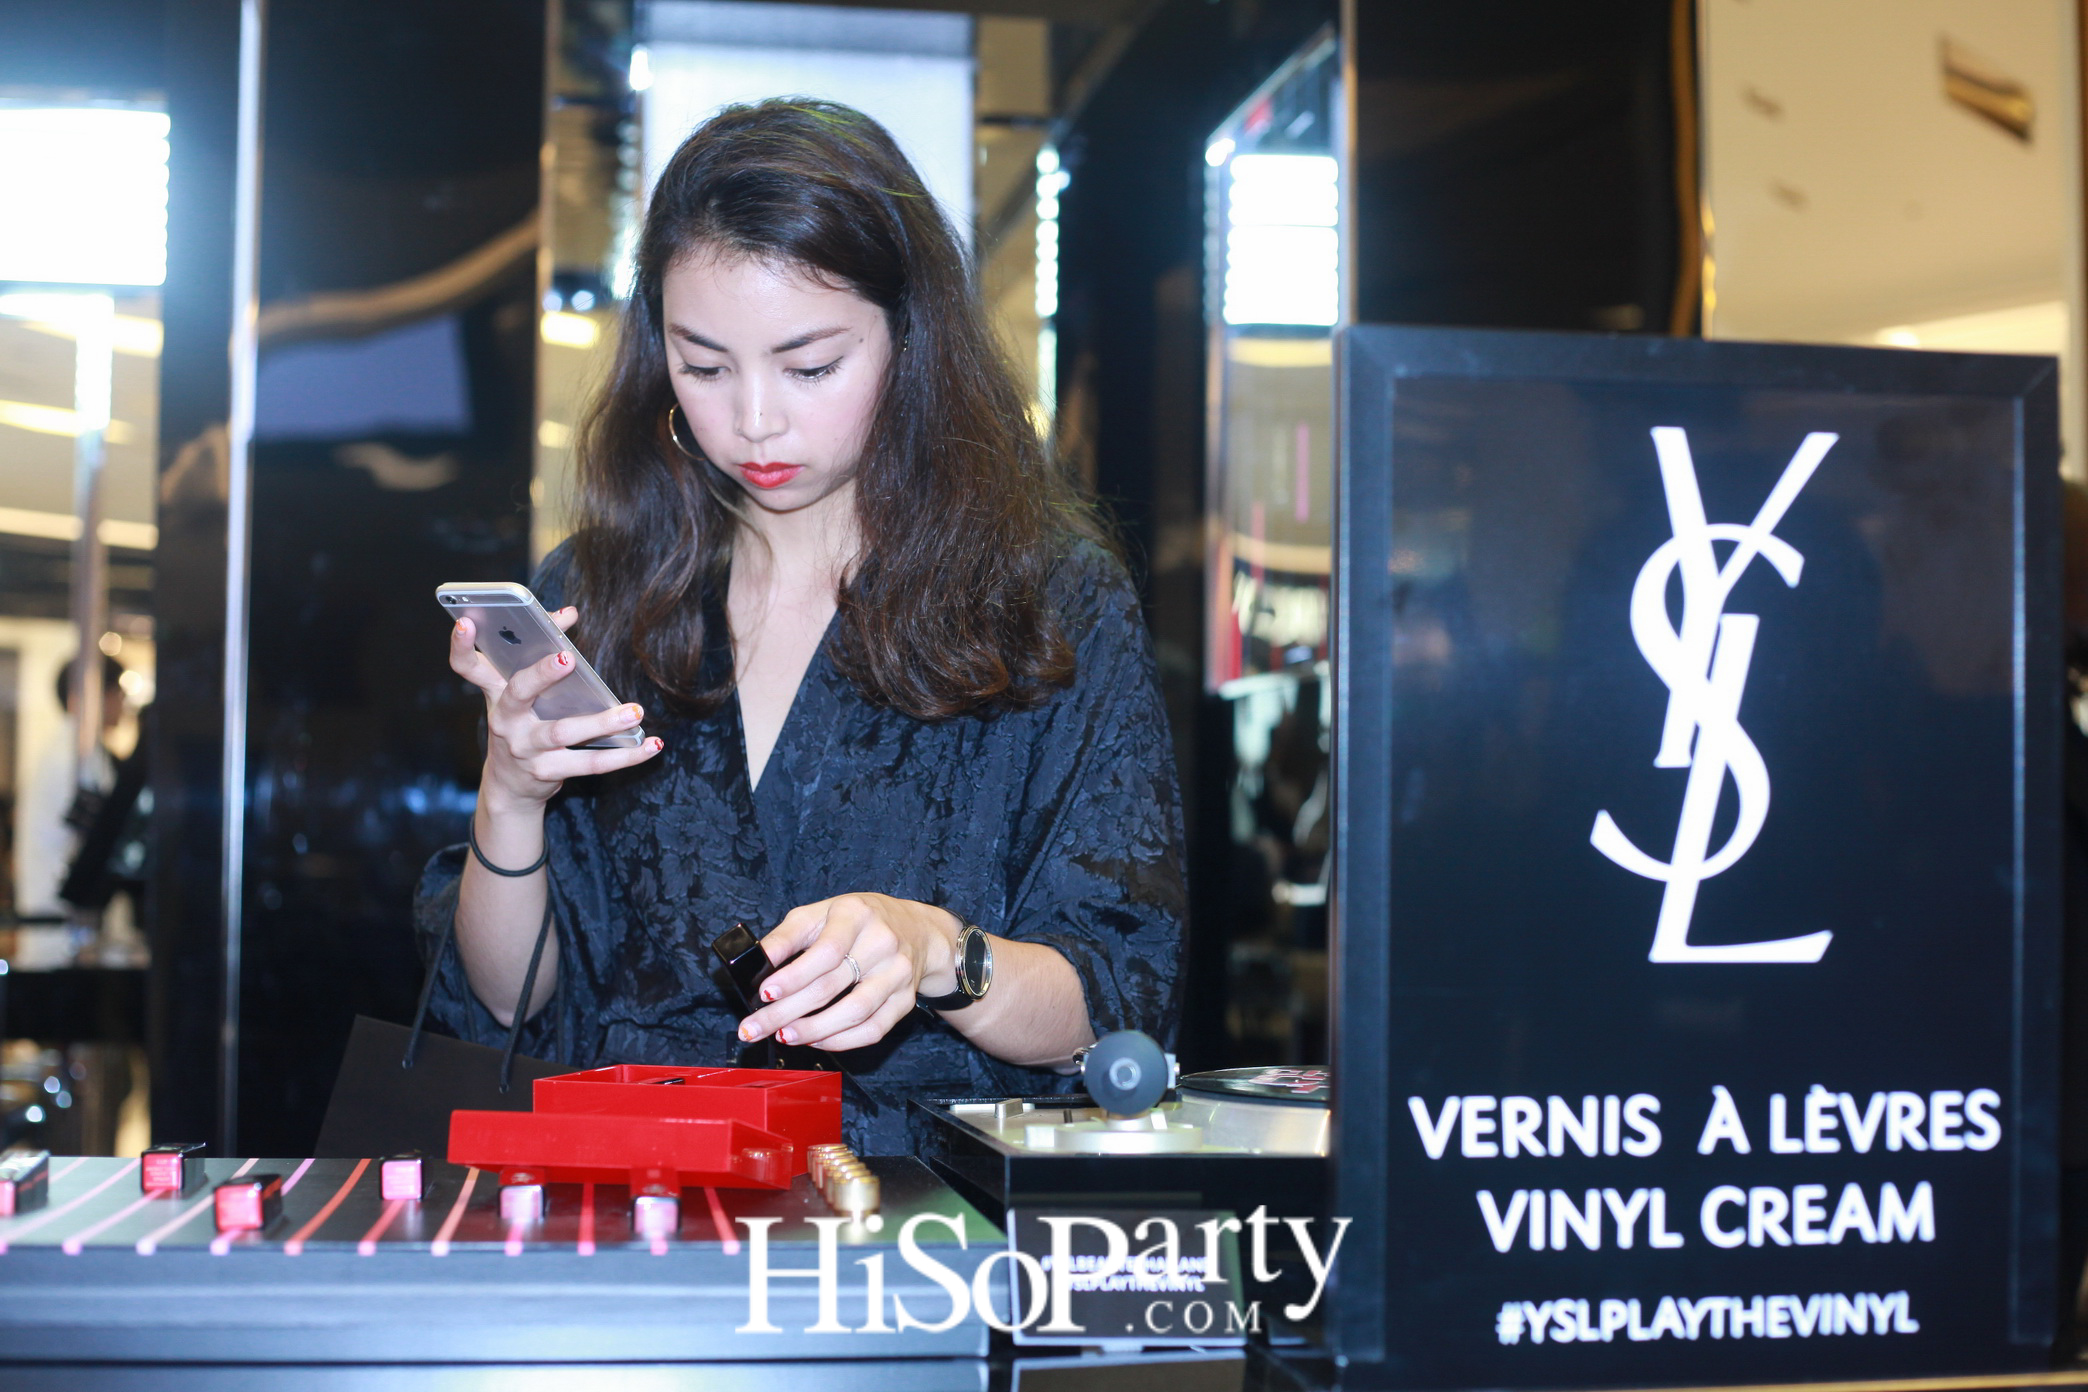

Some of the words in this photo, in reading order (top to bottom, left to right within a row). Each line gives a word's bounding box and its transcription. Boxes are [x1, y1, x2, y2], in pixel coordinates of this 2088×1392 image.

[1590, 426, 1839, 963] YSL
[1408, 1093, 1662, 1160] VERNIS
[1698, 1085, 1751, 1155] À
[1770, 1084, 2001, 1154] LÈVRES
[1476, 1188, 1684, 1253] VINYL
[1700, 1182, 1935, 1248] CREAM
[1496, 1292, 1919, 1345] #YSLPLAYTHEVINYL
